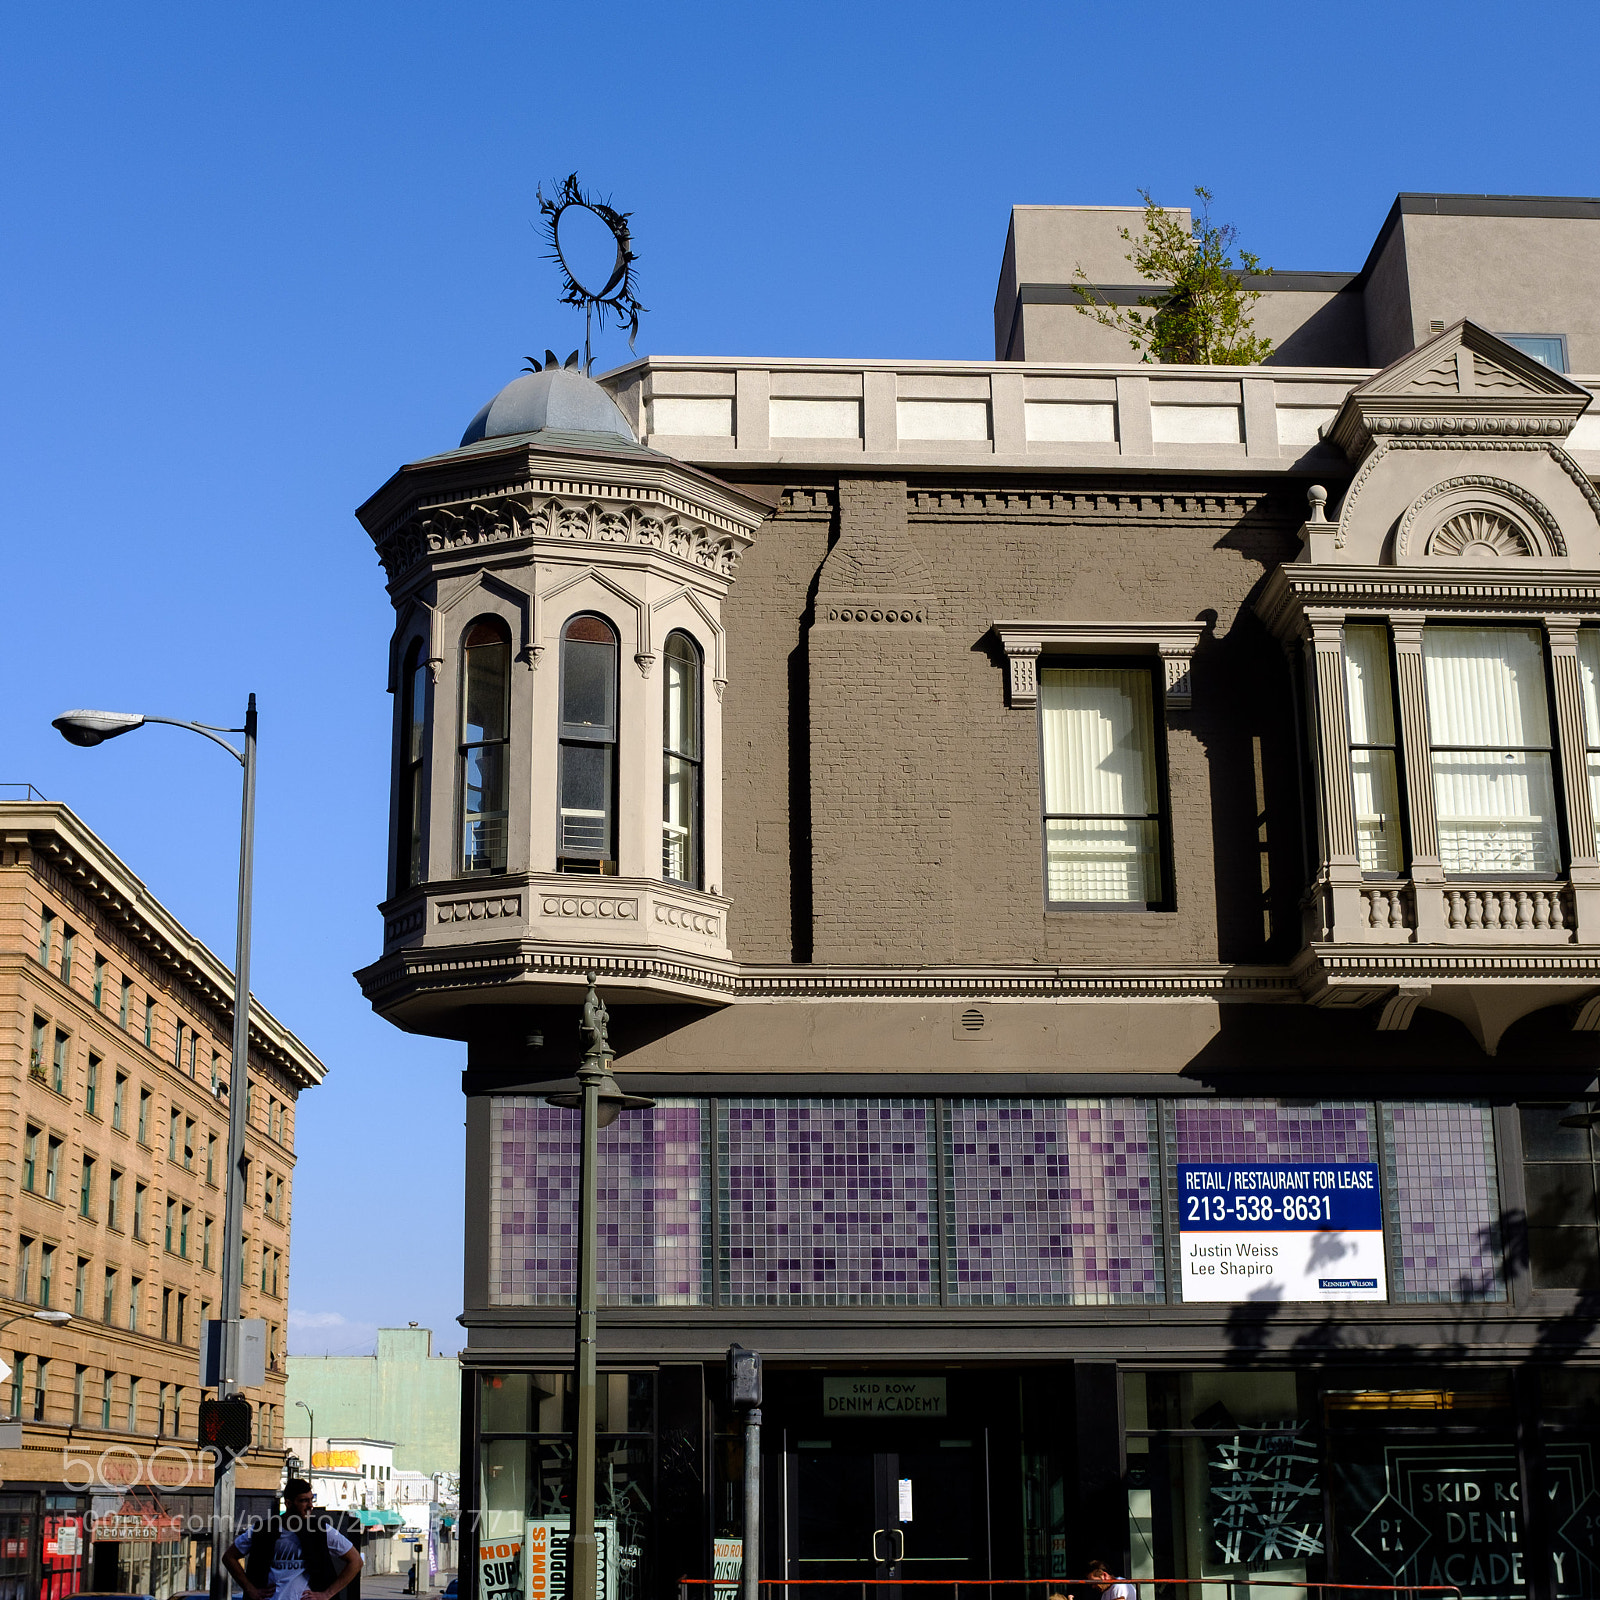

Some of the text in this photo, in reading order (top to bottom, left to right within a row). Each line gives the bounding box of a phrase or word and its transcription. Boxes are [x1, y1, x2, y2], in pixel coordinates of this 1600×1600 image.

[1186, 1171, 1225, 1190] RETAIL
[1234, 1171, 1311, 1190] RESTAURANT
[1313, 1171, 1336, 1189] FOR
[1338, 1170, 1374, 1189] LEASE
[1187, 1195, 1332, 1221] 213-538-8631
[1190, 1243, 1279, 1257] Justin Weiss
[1191, 1261, 1273, 1277] Lee Shapiro
[853, 1384, 917, 1393] SKID ROW
[828, 1397, 941, 1411] DENIM ACADEMY
[1421, 1482, 1481, 1503] SKID
[1445, 1511, 1518, 1544] DENI
[730, 1544, 743, 1558] RO
[1429, 1551, 1567, 1586] ACADEY
